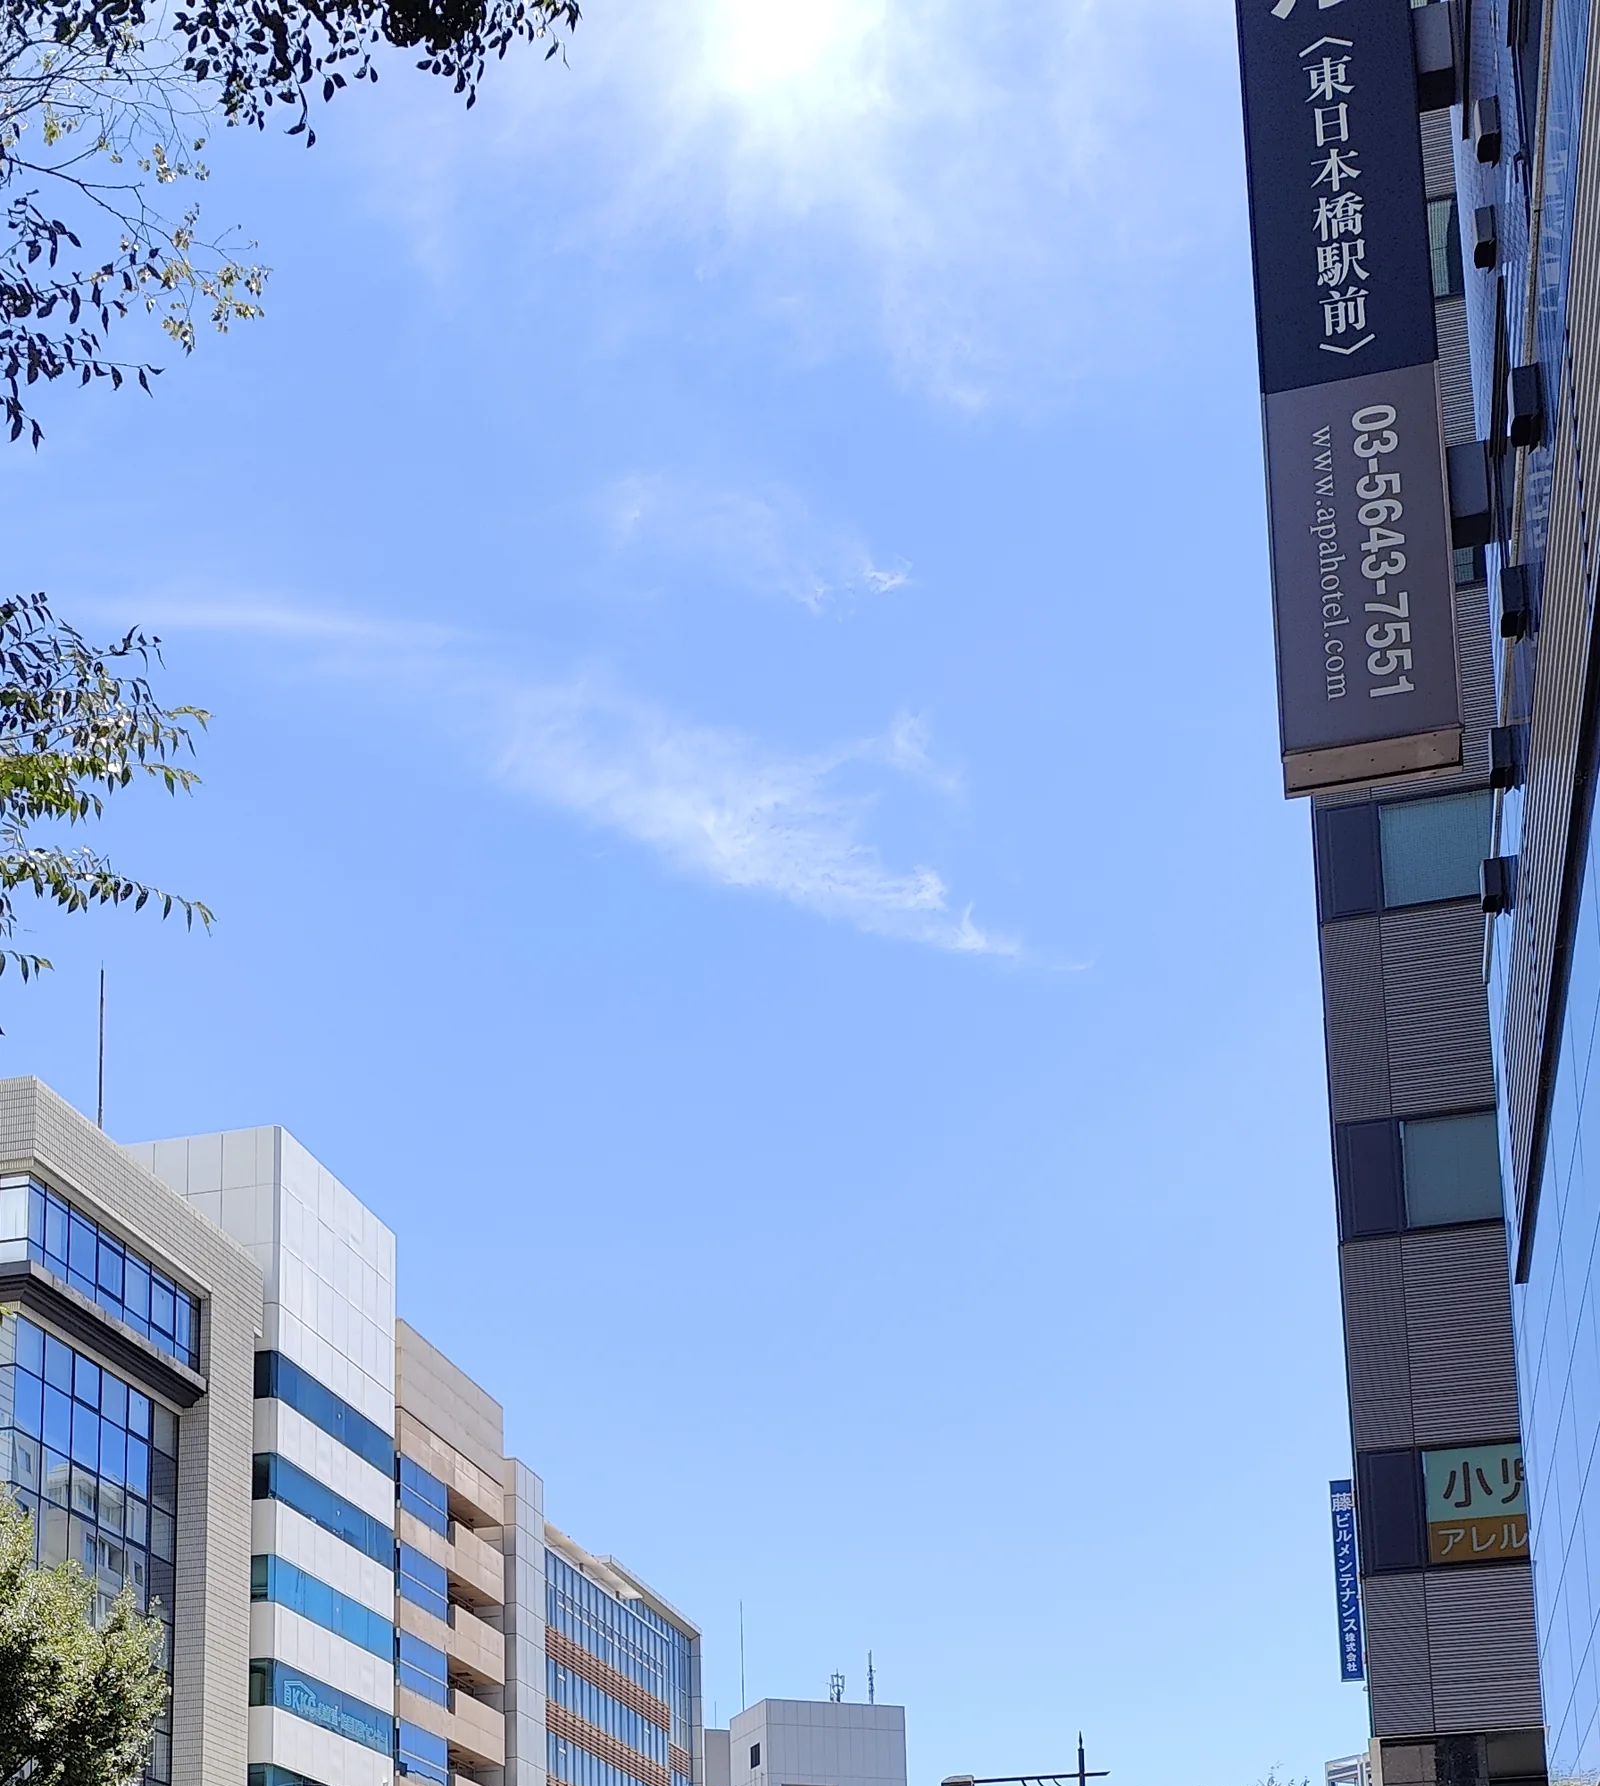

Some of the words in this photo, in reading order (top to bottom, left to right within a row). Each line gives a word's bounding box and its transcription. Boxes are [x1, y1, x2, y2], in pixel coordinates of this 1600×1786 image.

[1310, 424, 1347, 700] www.apahotel.com
[1351, 403, 1414, 698] 03-5643-7551
[1438, 1522, 1528, 1556] アレル
